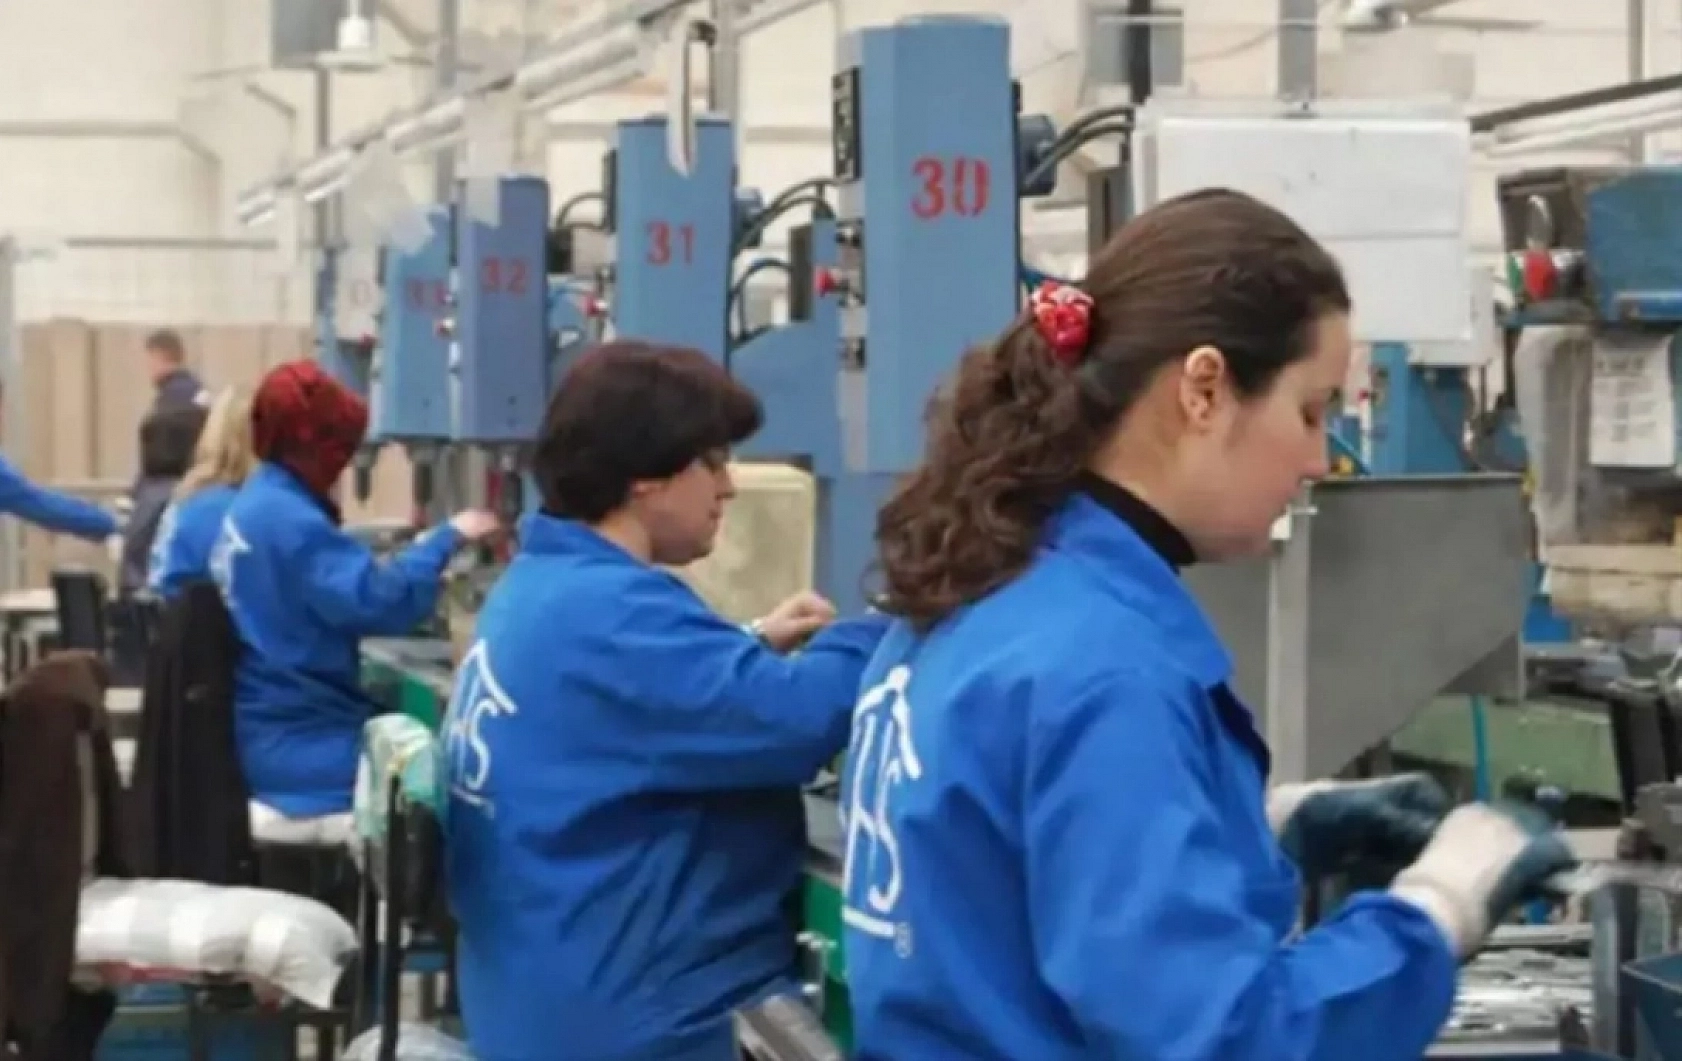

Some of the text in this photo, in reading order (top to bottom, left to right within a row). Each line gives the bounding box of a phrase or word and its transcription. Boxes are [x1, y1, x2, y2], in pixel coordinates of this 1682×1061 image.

[911, 155, 990, 218] 30
[646, 221, 696, 266] 31
[481, 256, 529, 295] 32
